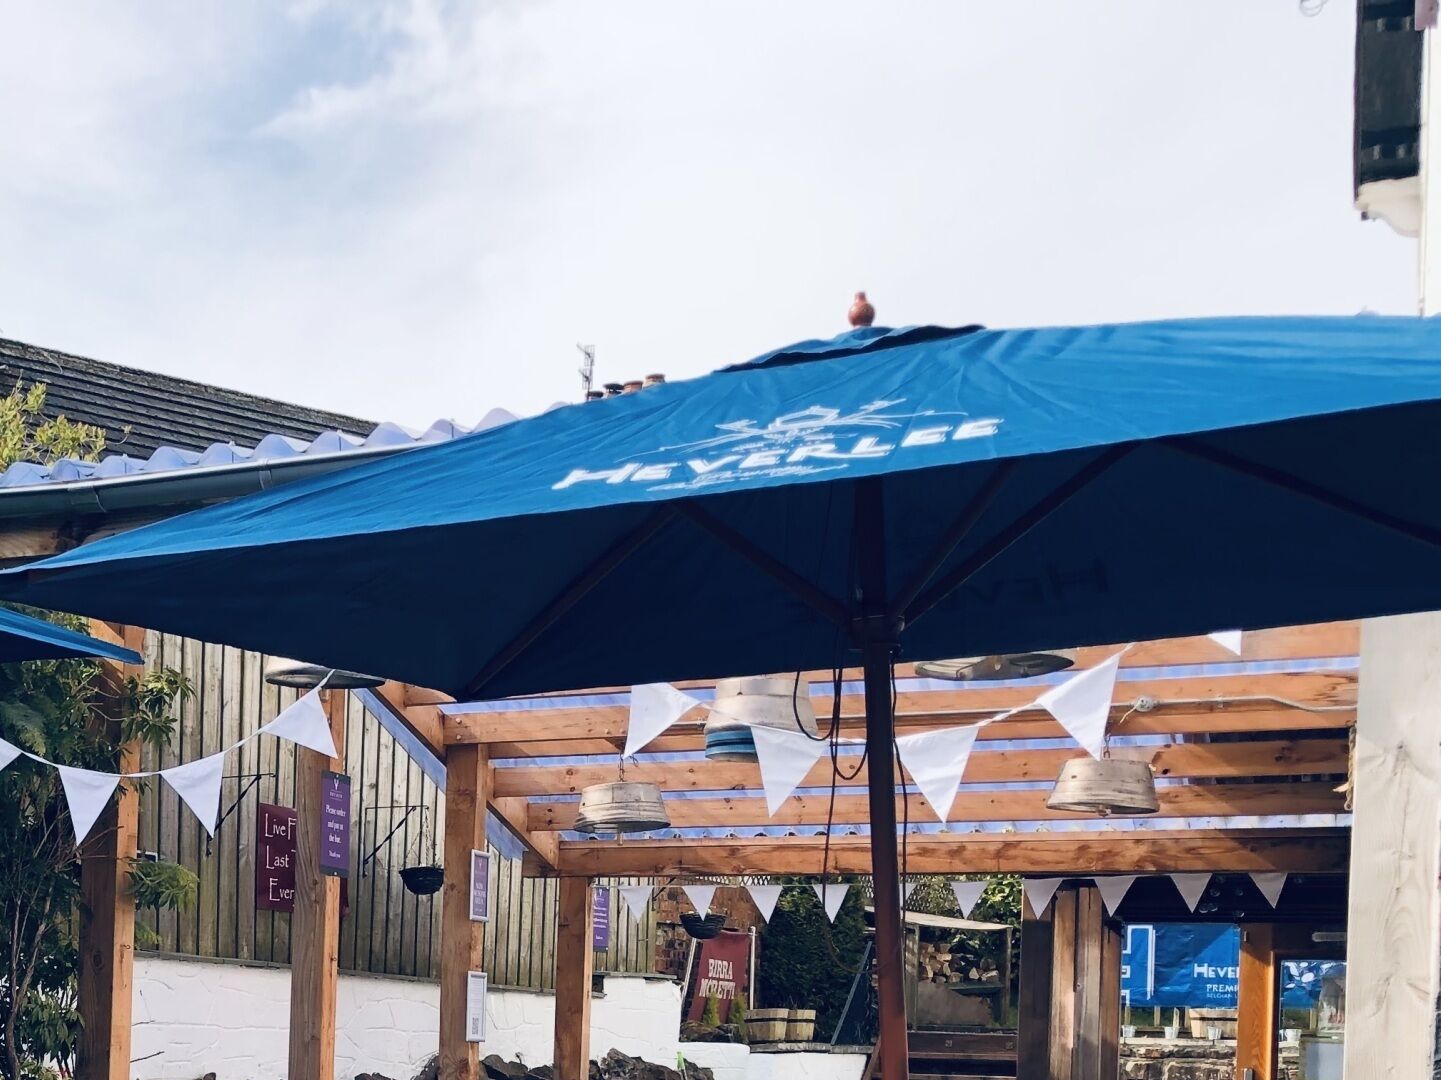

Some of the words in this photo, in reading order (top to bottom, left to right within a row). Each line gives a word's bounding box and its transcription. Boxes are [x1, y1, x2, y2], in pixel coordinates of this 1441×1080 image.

[551, 418, 1004, 490] HEVERLEE
[264, 813, 286, 837] Live
[266, 845, 290, 870] Last
[269, 877, 295, 905] Ever
[708, 959, 733, 979] BIRRA
[699, 978, 736, 1000] MORETTI
